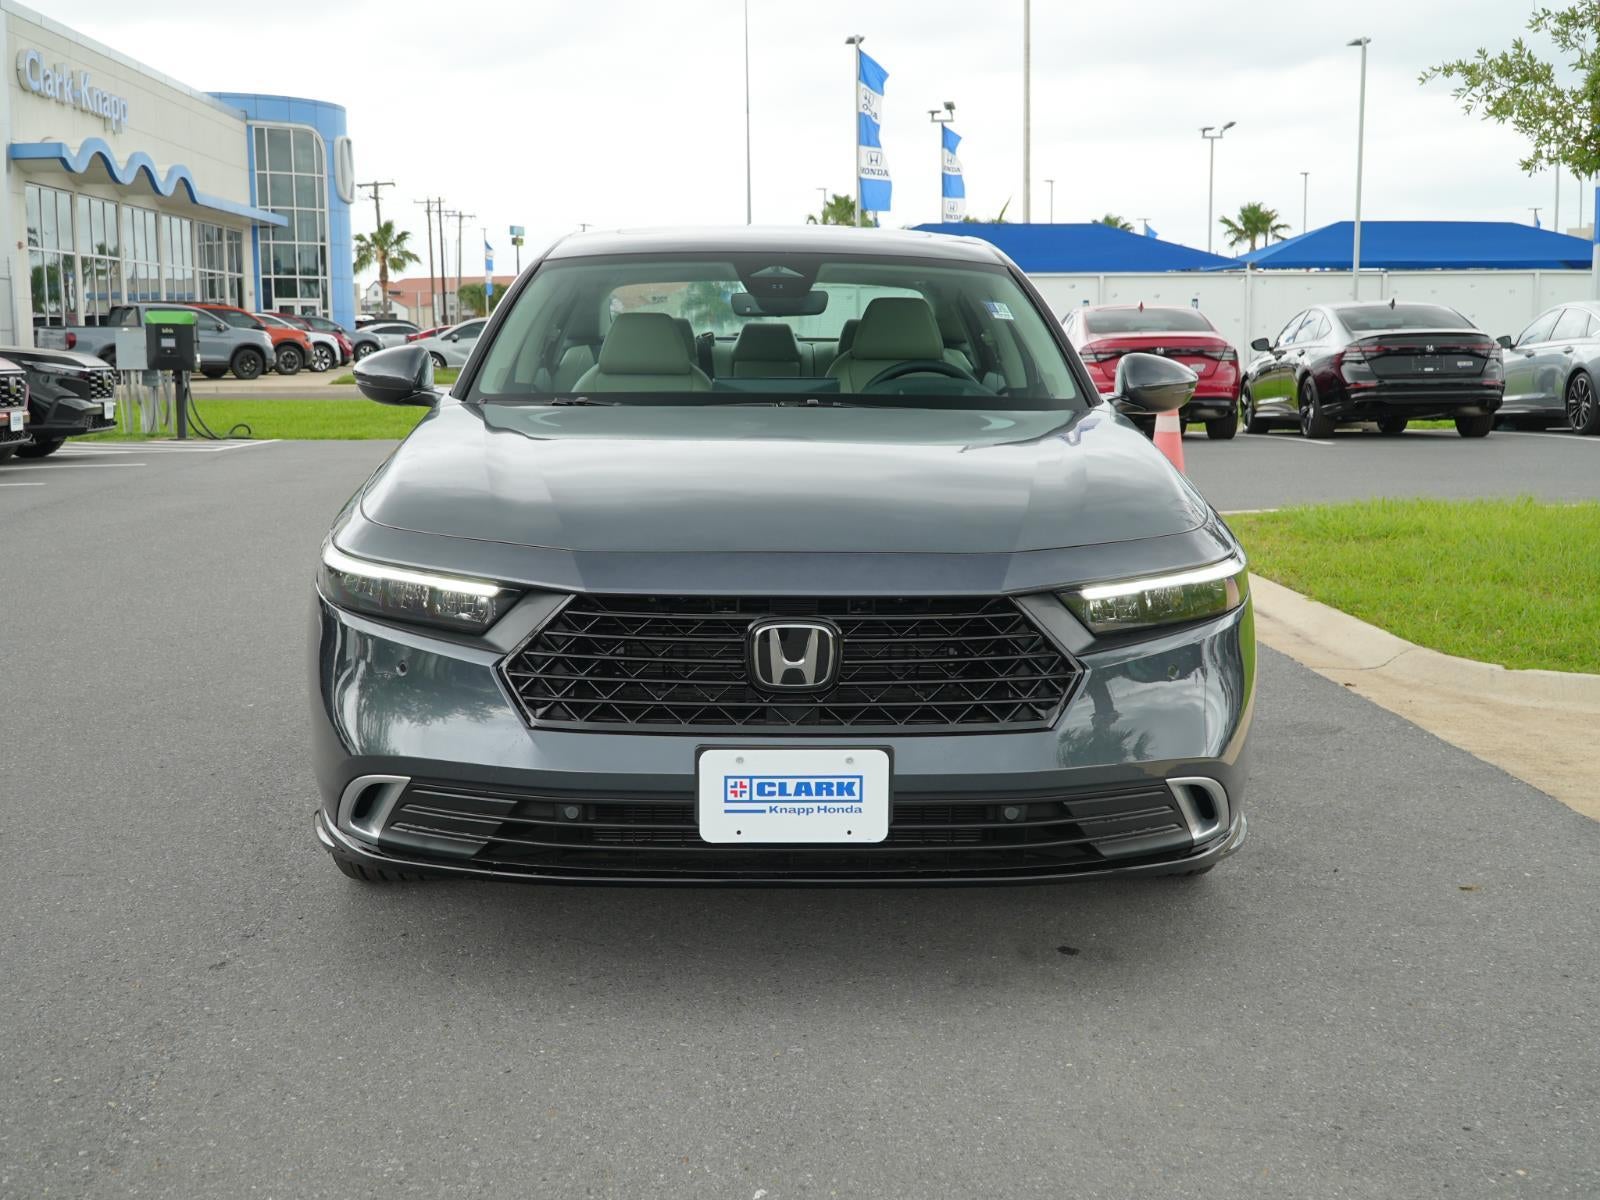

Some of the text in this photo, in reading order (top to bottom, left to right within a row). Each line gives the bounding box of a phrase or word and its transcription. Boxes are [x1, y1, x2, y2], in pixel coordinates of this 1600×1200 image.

[756, 781, 857, 797] CLARK
[769, 805, 863, 816] Knapp Honda
